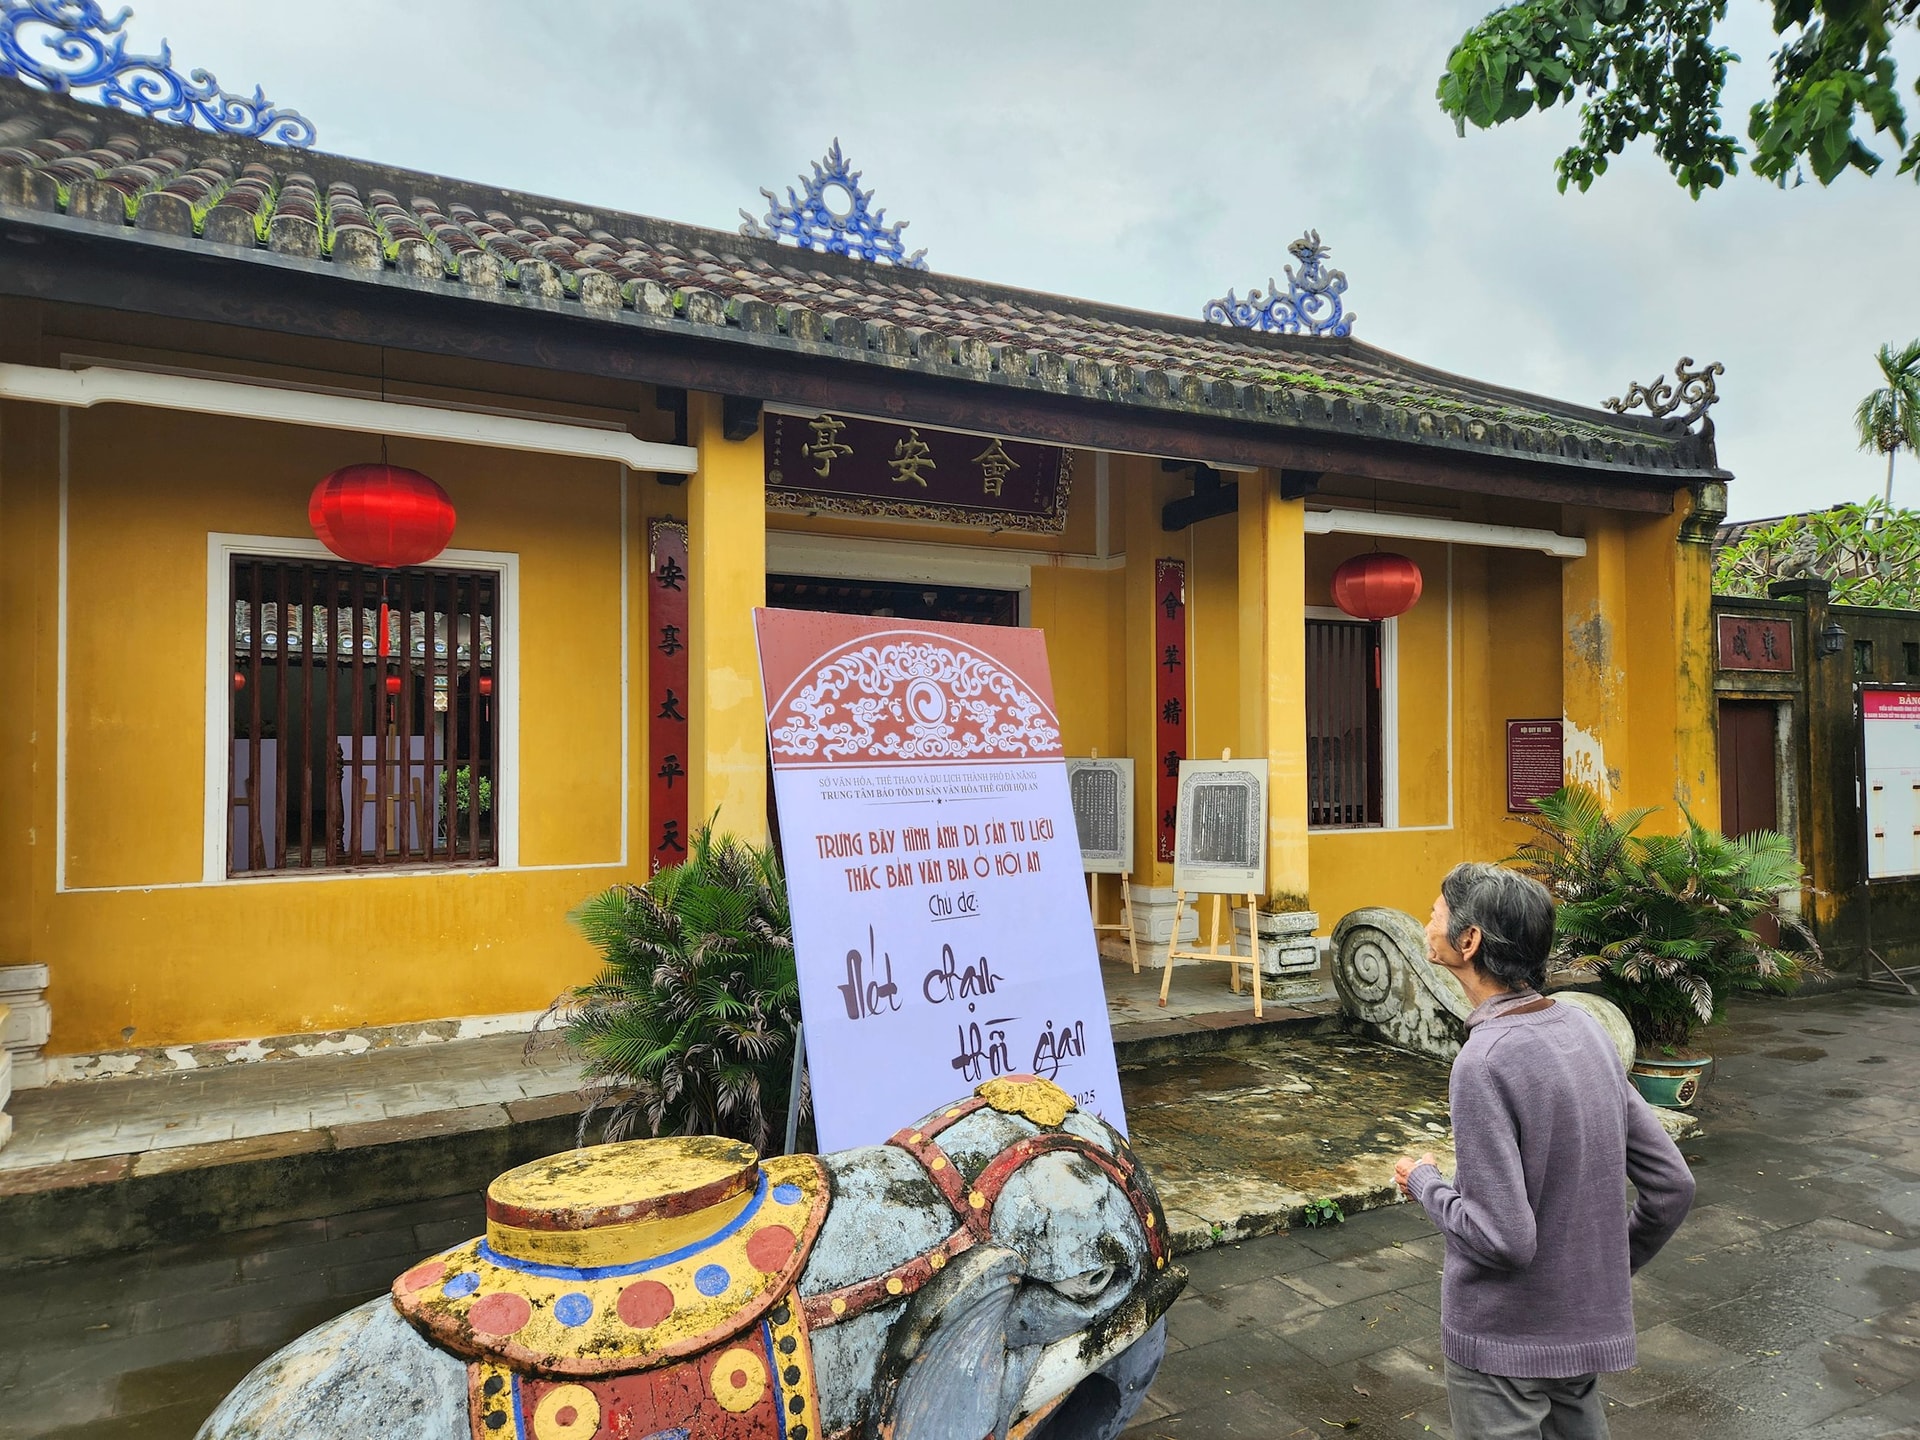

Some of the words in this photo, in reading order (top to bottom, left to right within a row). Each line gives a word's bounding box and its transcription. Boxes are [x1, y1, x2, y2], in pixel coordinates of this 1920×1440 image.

[655, 556, 687, 853] 安享太平天
[820, 790, 853, 801] TRUNG
[853, 787, 875, 799] TÂM
[876, 786, 895, 798] BẢO
[895, 786, 914, 797] TỒN
[915, 787, 925, 797] DI
[925, 785, 942, 796] SẢN
[942, 784, 960, 795] VĂN
[1013, 782, 1028, 793] HỘI
[1028, 782, 1039, 791] AN
[832, 776, 852, 787] VĂN
[893, 774, 916, 785] THAO
[916, 773, 929, 784] VÀ
[930, 774, 942, 784] DU
[943, 773, 961, 784] LỊCH
[962, 771, 988, 782] THÀNH
[868, 828, 895, 855] BÀY
[902, 826, 931, 852] HÌNH
[937, 819, 959, 849] ẢNH
[963, 824, 979, 847] DI
[984, 817, 1007, 845] SẢN
[1028, 817, 1054, 842] LIỆU
[845, 864, 881, 892] THÁC
[886, 856, 913, 888] BẢN
[918, 859, 942, 885] VĂN
[947, 858, 969, 881] BIA
[974, 850, 990, 878] Ở
[994, 851, 1022, 877] HỘI
[1027, 851, 1041, 872] AN
[929, 891, 952, 916] Chủ
[1033, 1020, 1086, 1082] gian
